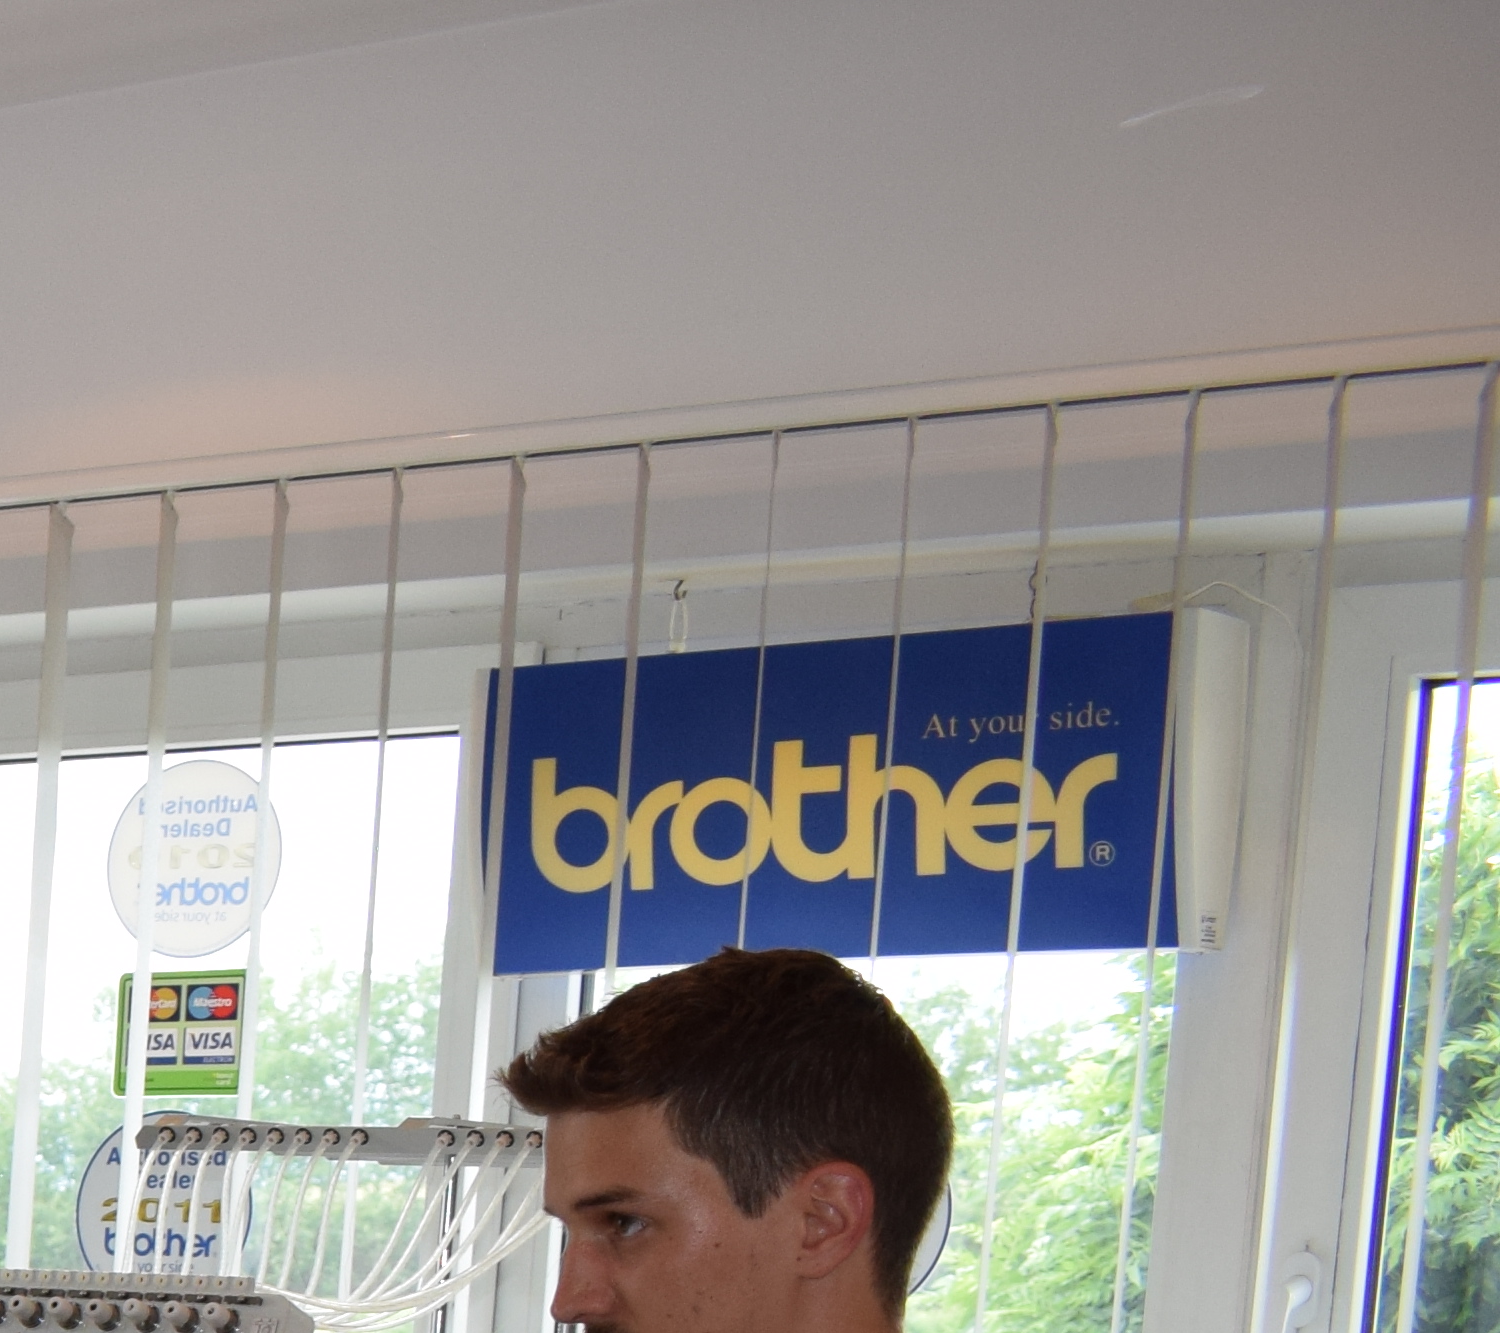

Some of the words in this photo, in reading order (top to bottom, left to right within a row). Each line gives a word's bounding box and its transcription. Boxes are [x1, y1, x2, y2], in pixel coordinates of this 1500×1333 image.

[921, 711, 962, 741] At
[1049, 702, 1121, 732] side.
[532, 734, 1119, 894] brother
[193, 997, 233, 1008] Maestro
[146, 1033, 175, 1051] ISA
[189, 1032, 233, 1050] VISA
